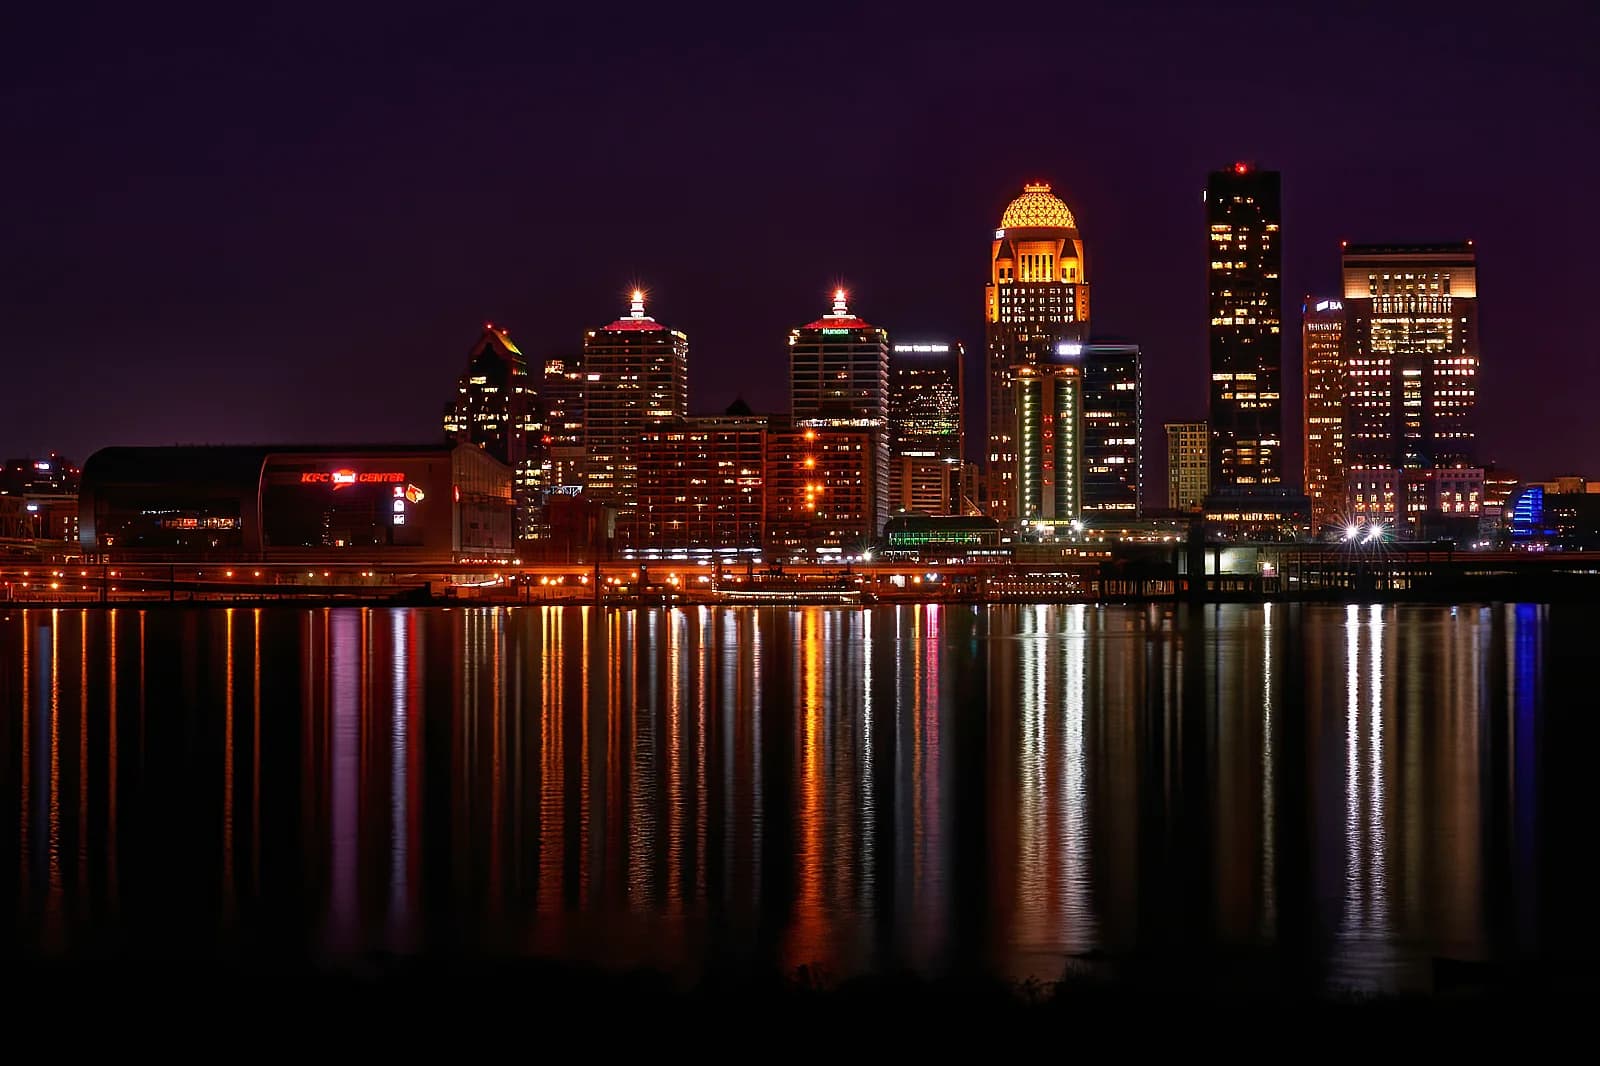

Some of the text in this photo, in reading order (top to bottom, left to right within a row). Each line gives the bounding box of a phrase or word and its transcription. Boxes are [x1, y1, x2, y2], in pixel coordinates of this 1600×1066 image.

[822, 327, 849, 335] Humana
[300, 472, 405, 483] KFC Yum! CENTER
